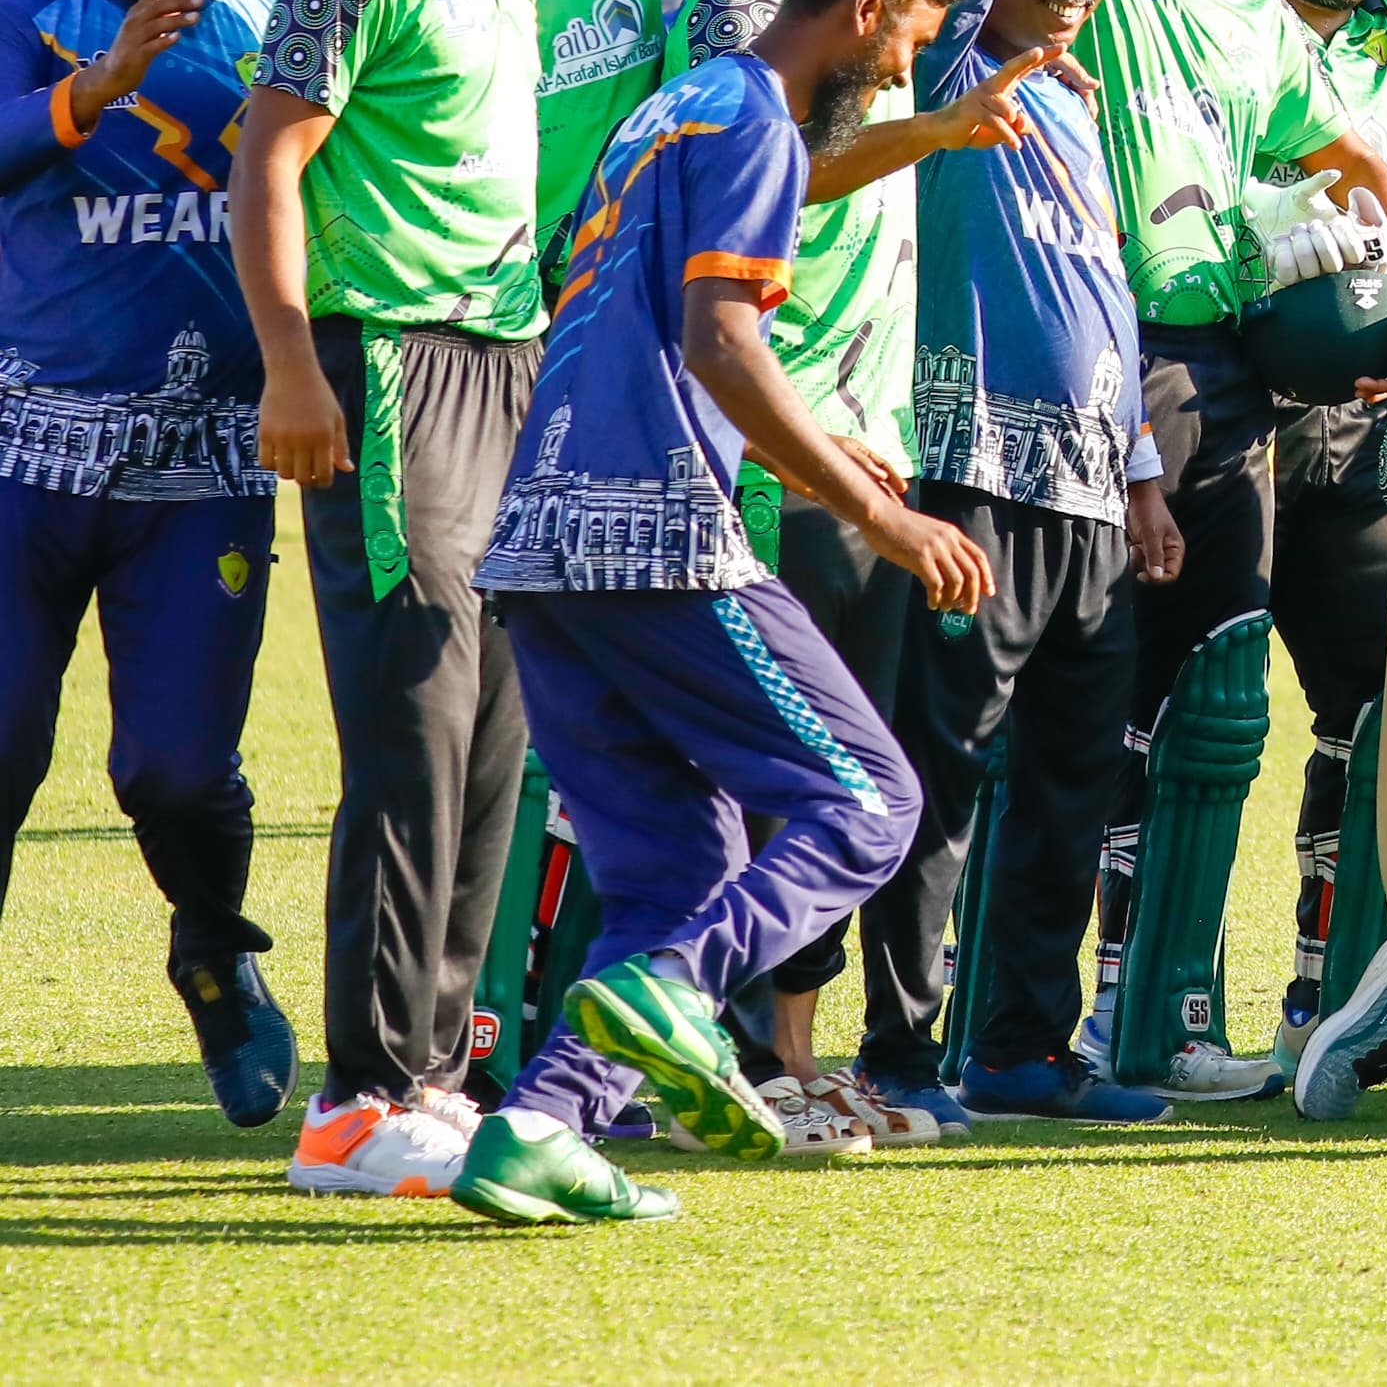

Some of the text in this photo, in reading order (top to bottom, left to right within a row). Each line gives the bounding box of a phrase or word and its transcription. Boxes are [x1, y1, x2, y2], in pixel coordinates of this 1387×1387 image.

[556, 20, 601, 59] aib
[1349, 278, 1383, 290] SHREY
[941, 612, 967, 629] NCL
[1189, 998, 1209, 1025] SS
[474, 1024, 494, 1049] S
